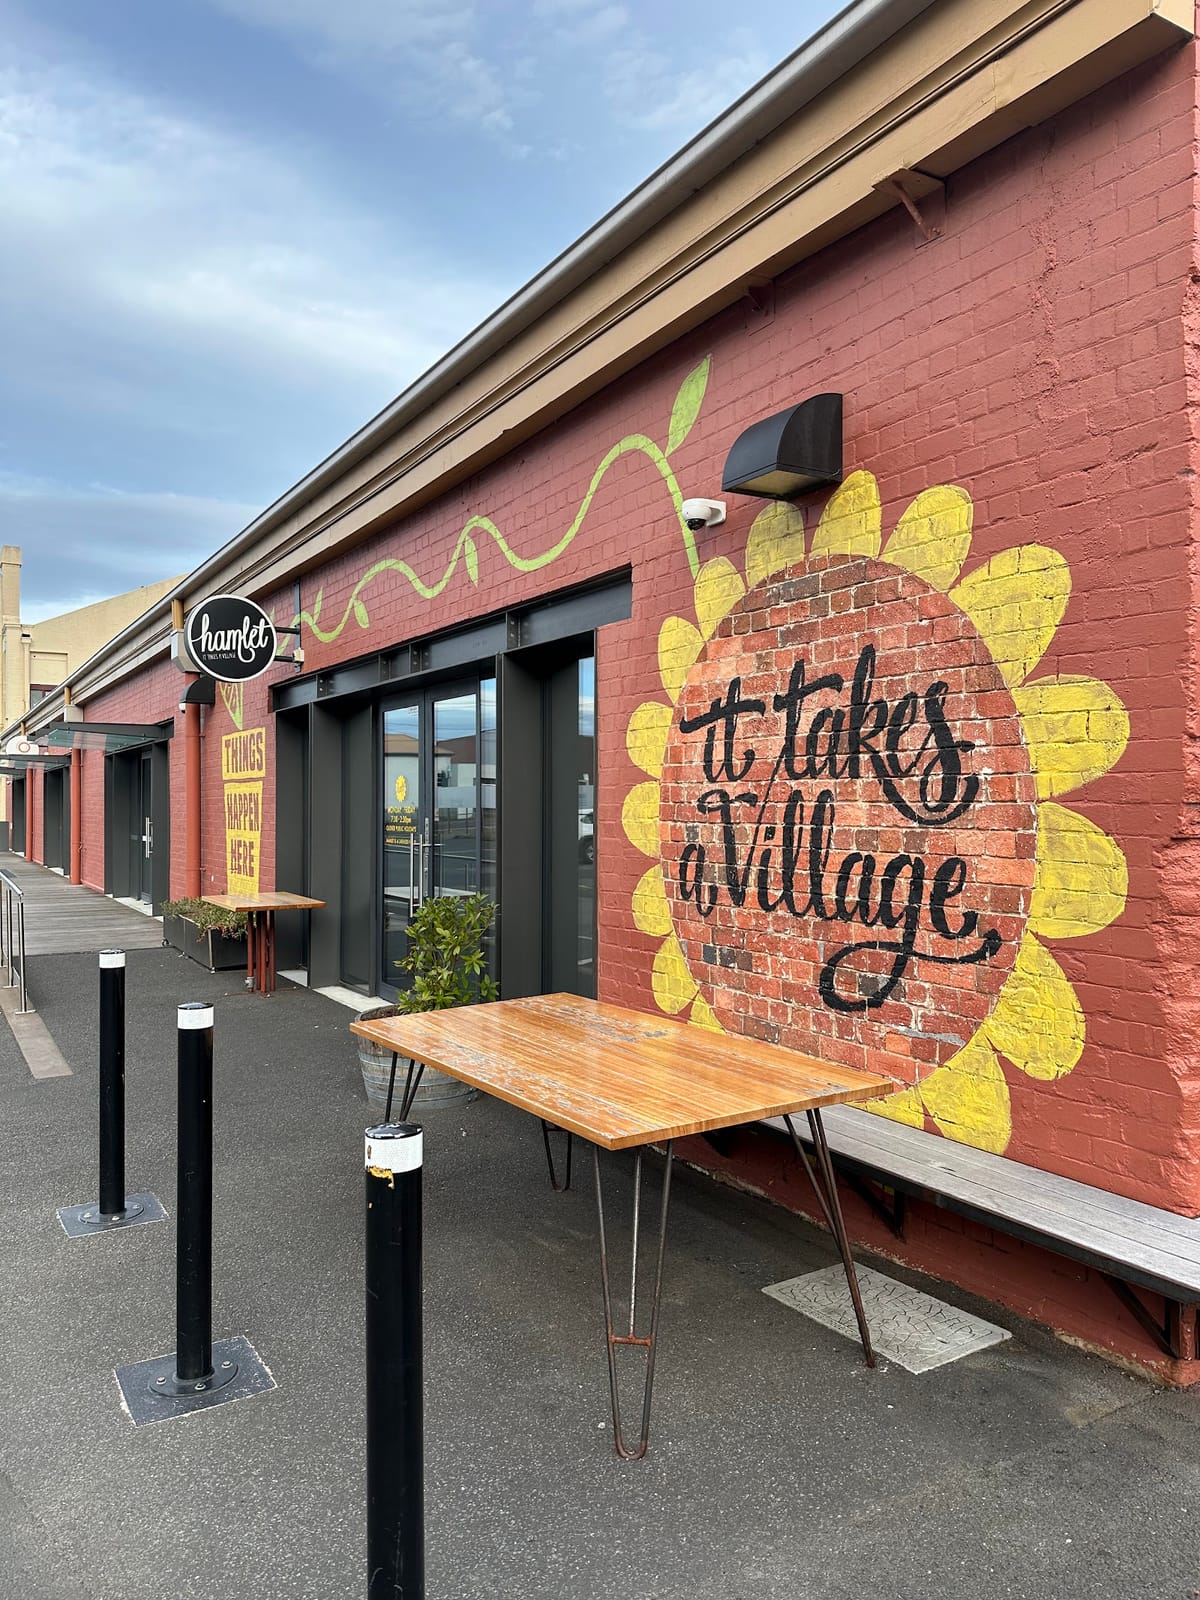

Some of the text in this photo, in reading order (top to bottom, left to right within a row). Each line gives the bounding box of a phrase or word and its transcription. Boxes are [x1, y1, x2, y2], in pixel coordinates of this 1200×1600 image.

[193, 613, 271, 663] hamlet
[224, 731, 263, 774] THINGS
[680, 643, 980, 825] it takes
[226, 792, 259, 832] HAPPEN
[230, 838, 255, 878] HERE
[679, 843, 717, 917] a
